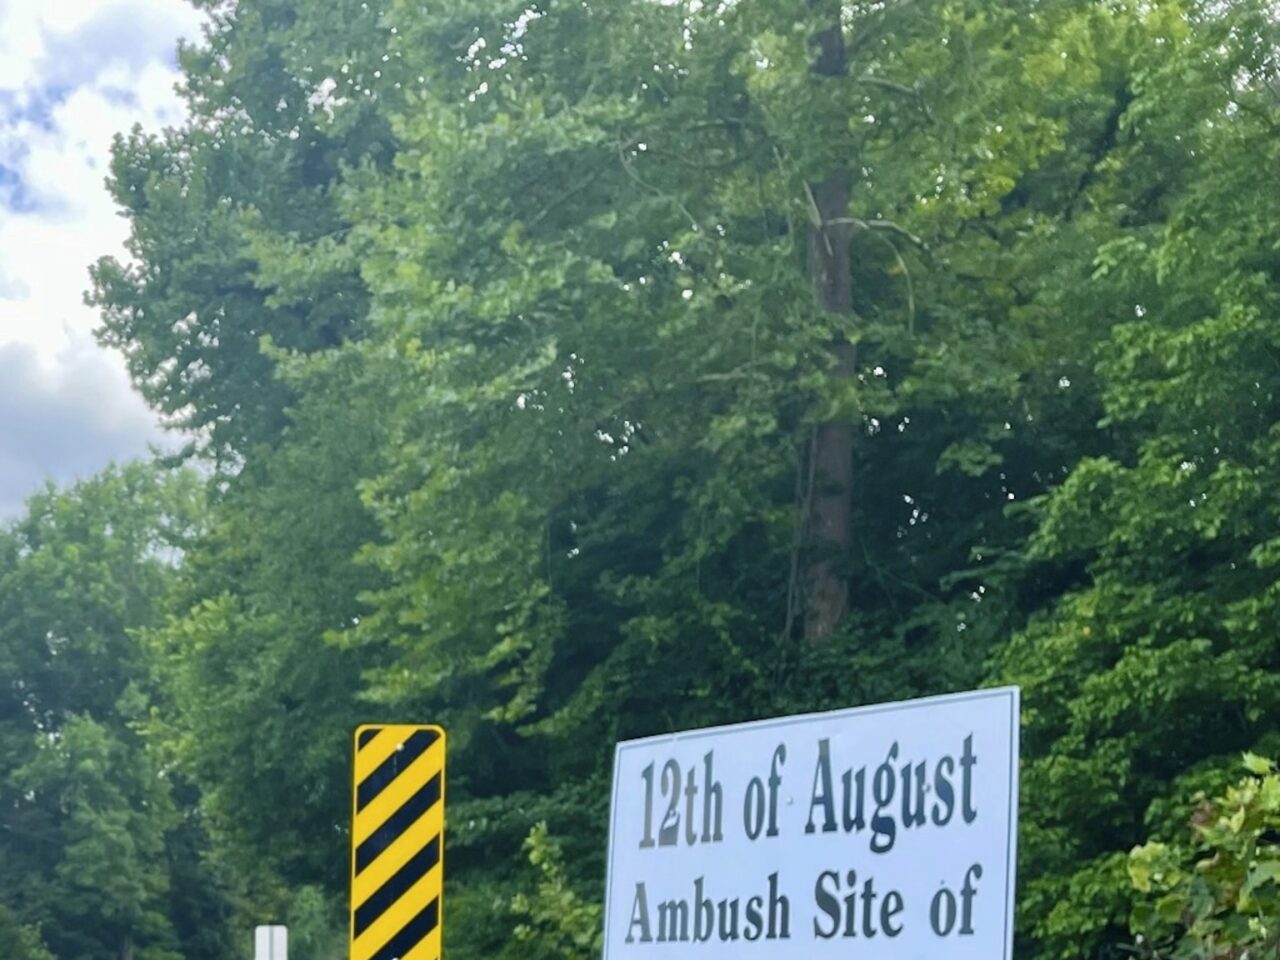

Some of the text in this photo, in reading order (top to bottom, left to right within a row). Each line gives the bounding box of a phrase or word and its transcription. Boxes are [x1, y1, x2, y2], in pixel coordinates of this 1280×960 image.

[638, 732, 978, 854] 12th of August
[624, 862, 983, 944] Ambush Site of
